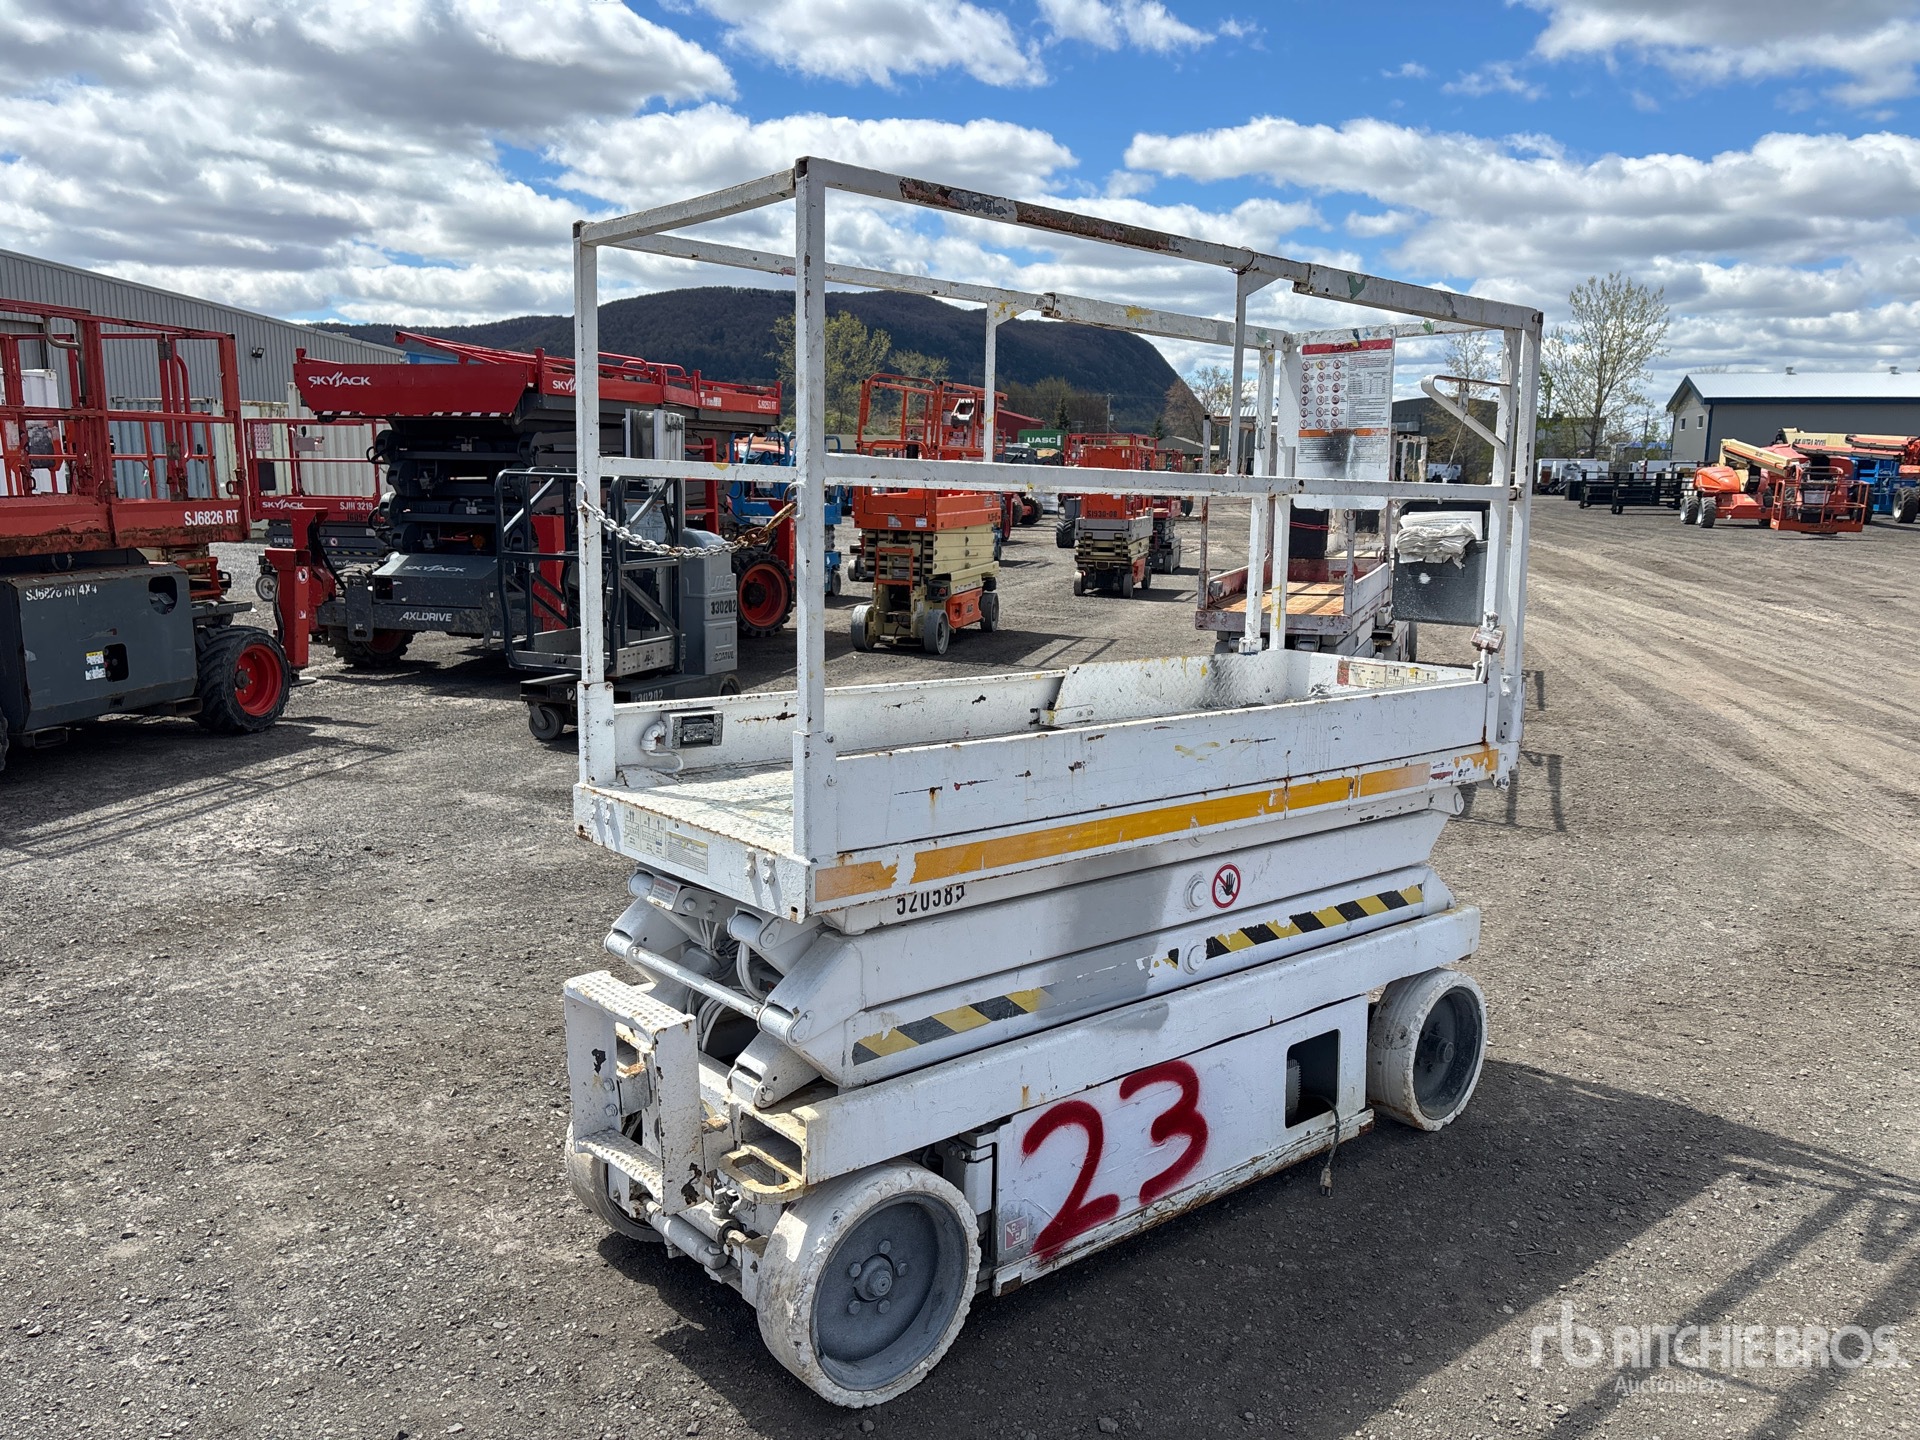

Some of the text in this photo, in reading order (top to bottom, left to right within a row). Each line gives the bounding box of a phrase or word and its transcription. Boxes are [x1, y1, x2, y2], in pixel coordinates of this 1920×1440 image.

[308, 371, 372, 388] SKYJACK
[262, 499, 304, 509] SKYJACK
[356, 502, 373, 511] 3219
[184, 510, 239, 526] SJ6826 RT
[399, 612, 452, 622] AXLDRIVE
[1021, 1060, 1208, 1260] 23
